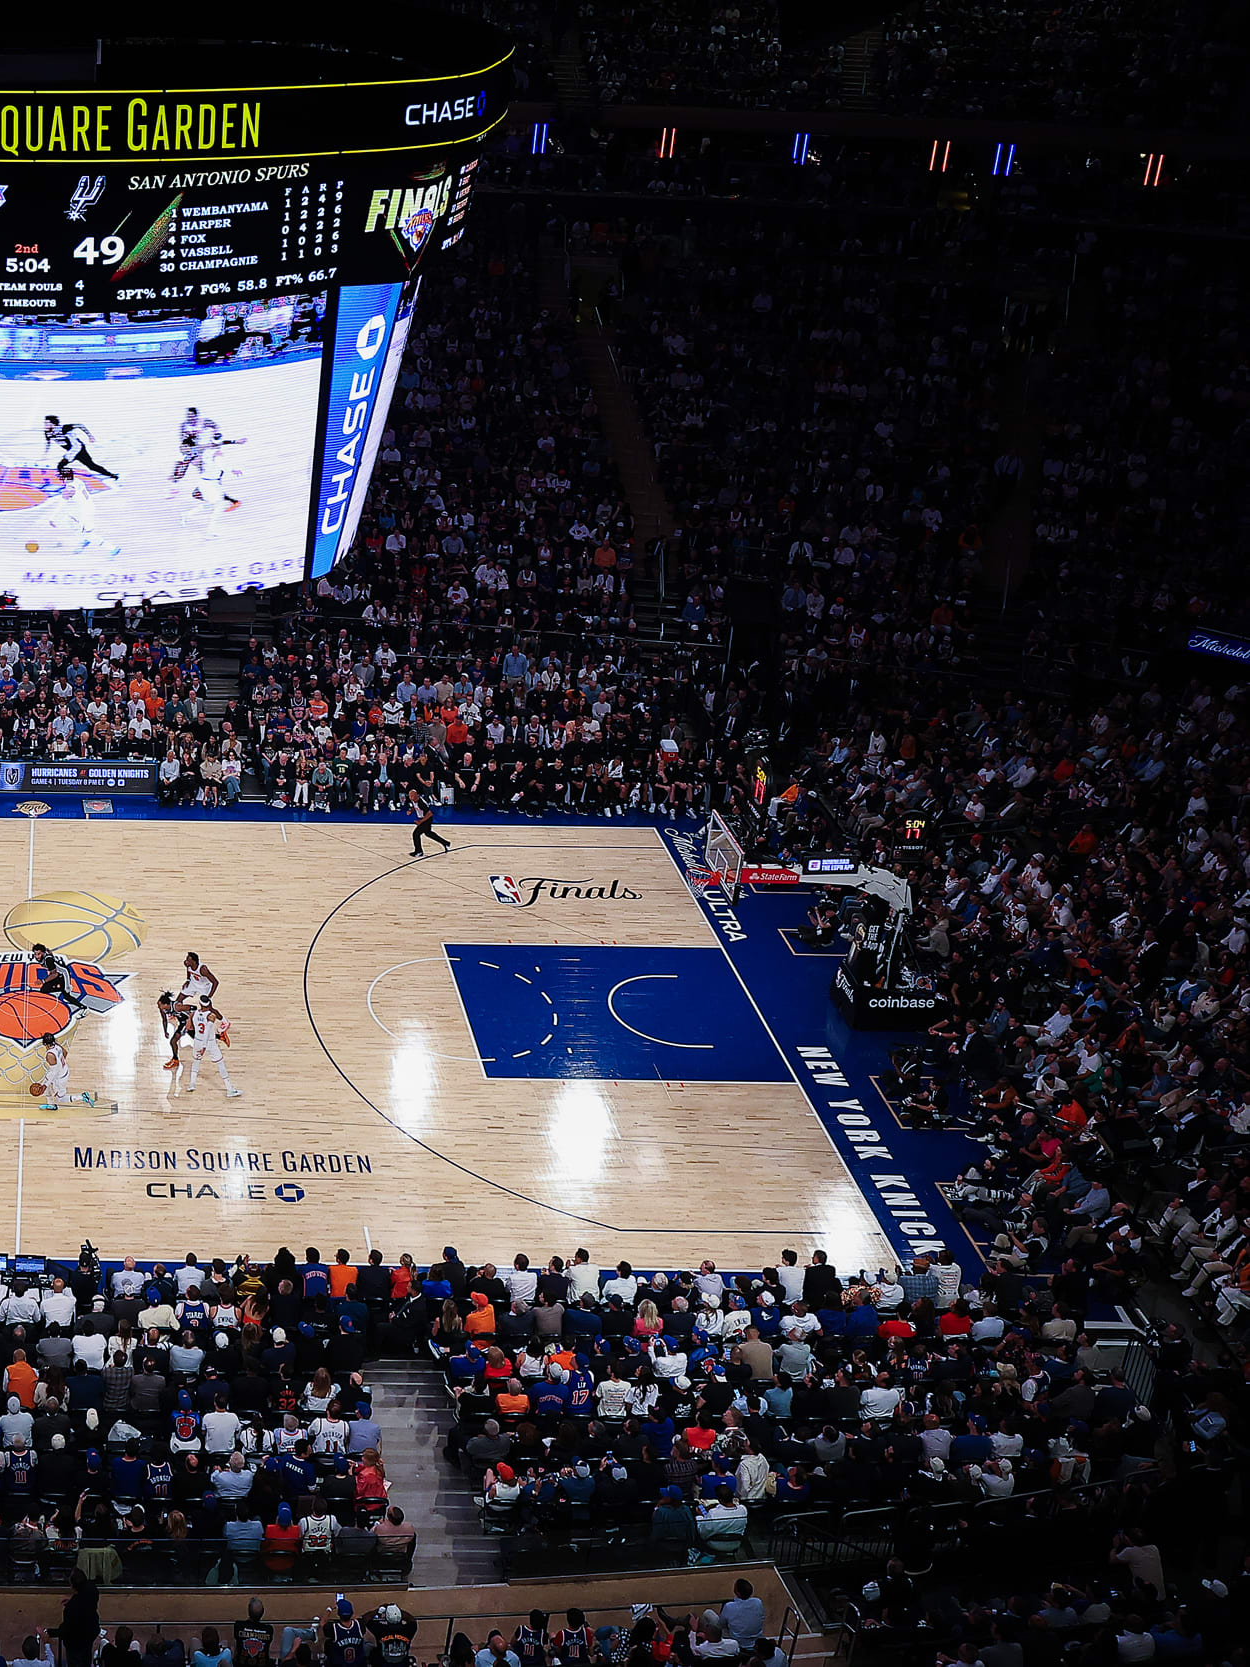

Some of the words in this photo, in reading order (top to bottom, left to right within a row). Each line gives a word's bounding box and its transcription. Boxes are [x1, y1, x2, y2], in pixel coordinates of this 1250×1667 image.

[405, 96, 476, 126] CHASE
[126, 97, 261, 151] GARDEN
[128, 174, 166, 190] SAN
[169, 168, 251, 188] ANTONIO
[255, 163, 310, 182] SPURS
[284, 187, 292, 196] F
[302, 185, 310, 194] A
[319, 183, 327, 192] R
[336, 180, 344, 189] P
[171, 208, 178, 218] 1
[182, 201, 269, 218] WEMBANYAMA
[284, 199, 291, 208] 1
[301, 197, 309, 206] 2
[318, 194, 326, 203] 4
[335, 191, 343, 201] 9
[364, 175, 453, 232] FINALS
[168, 222, 177, 232] 2
[181, 218, 232, 231] HARPER
[284, 212, 290, 221] 1
[300, 210, 308, 219] 2
[317, 207, 325, 217] 2
[334, 204, 342, 214] 6
[167, 235, 176, 245] 4
[180, 234, 207, 244] FOX
[281, 225, 290, 234] 0
[299, 223, 307, 232] 4
[316, 220, 324, 230] 2
[333, 218, 341, 227] 2
[14, 243, 39, 254] 2nd
[73, 235, 125, 265] 49
[159, 249, 176, 260] 24
[180, 245, 234, 258] VASSELL
[281, 238, 288, 248] 1
[298, 236, 306, 245] 0
[315, 234, 323, 243] 2
[332, 231, 340, 240] 6
[5, 257, 51, 273] 5:04
[159, 263, 175, 273] 30
[179, 255, 259, 271] CHAMPAGNIE
[281, 252, 287, 261] 1
[298, 249, 305, 259] 1
[314, 246, 322, 256] 0
[330, 243, 338, 254] 3
[29, 283, 63, 291] FOULS
[75, 280, 84, 290] 4
[117, 288, 156, 301] 3PT%
[161, 285, 194, 298] 41.7
[200, 282, 231, 295] FG%
[237, 278, 268, 292] 58.8
[275, 273, 304, 287] FT%
[308, 267, 337, 282] 66.7
[2, 299, 57, 307] TIMEOUTS
[75, 296, 84, 307] 5
[321, 366, 376, 535] CHASE
[31, 768, 78, 778] HURRICANES
[88, 769, 116, 778] GOLDEN
[117, 769, 149, 779] KNIGHTS
[905, 820, 926, 829] 5:04
[906, 829, 921, 839] 17
[760, 872, 798, 881] StateFarm
[519, 877, 643, 908] Finals
[703, 890, 748, 942] ULTRA
[869, 995, 935, 1008] coinbase
[74, 1146, 177, 1171] MADISON
[186, 1148, 274, 1173] SQUARE
[282, 1151, 372, 1174] GARDEN
[796, 1046, 850, 1088] NEW
[828, 1099, 893, 1161] YORK
[870, 1174, 948, 1256] KNICK
[146, 1183, 267, 1200] CHASE
[278, 1398, 297, 1411] 32
[572, 1390, 590, 1405] 17
[15, 1470, 27, 1484] 11
[155, 1484, 168, 1496] 11
[569, 1645, 580, 1658] 11
